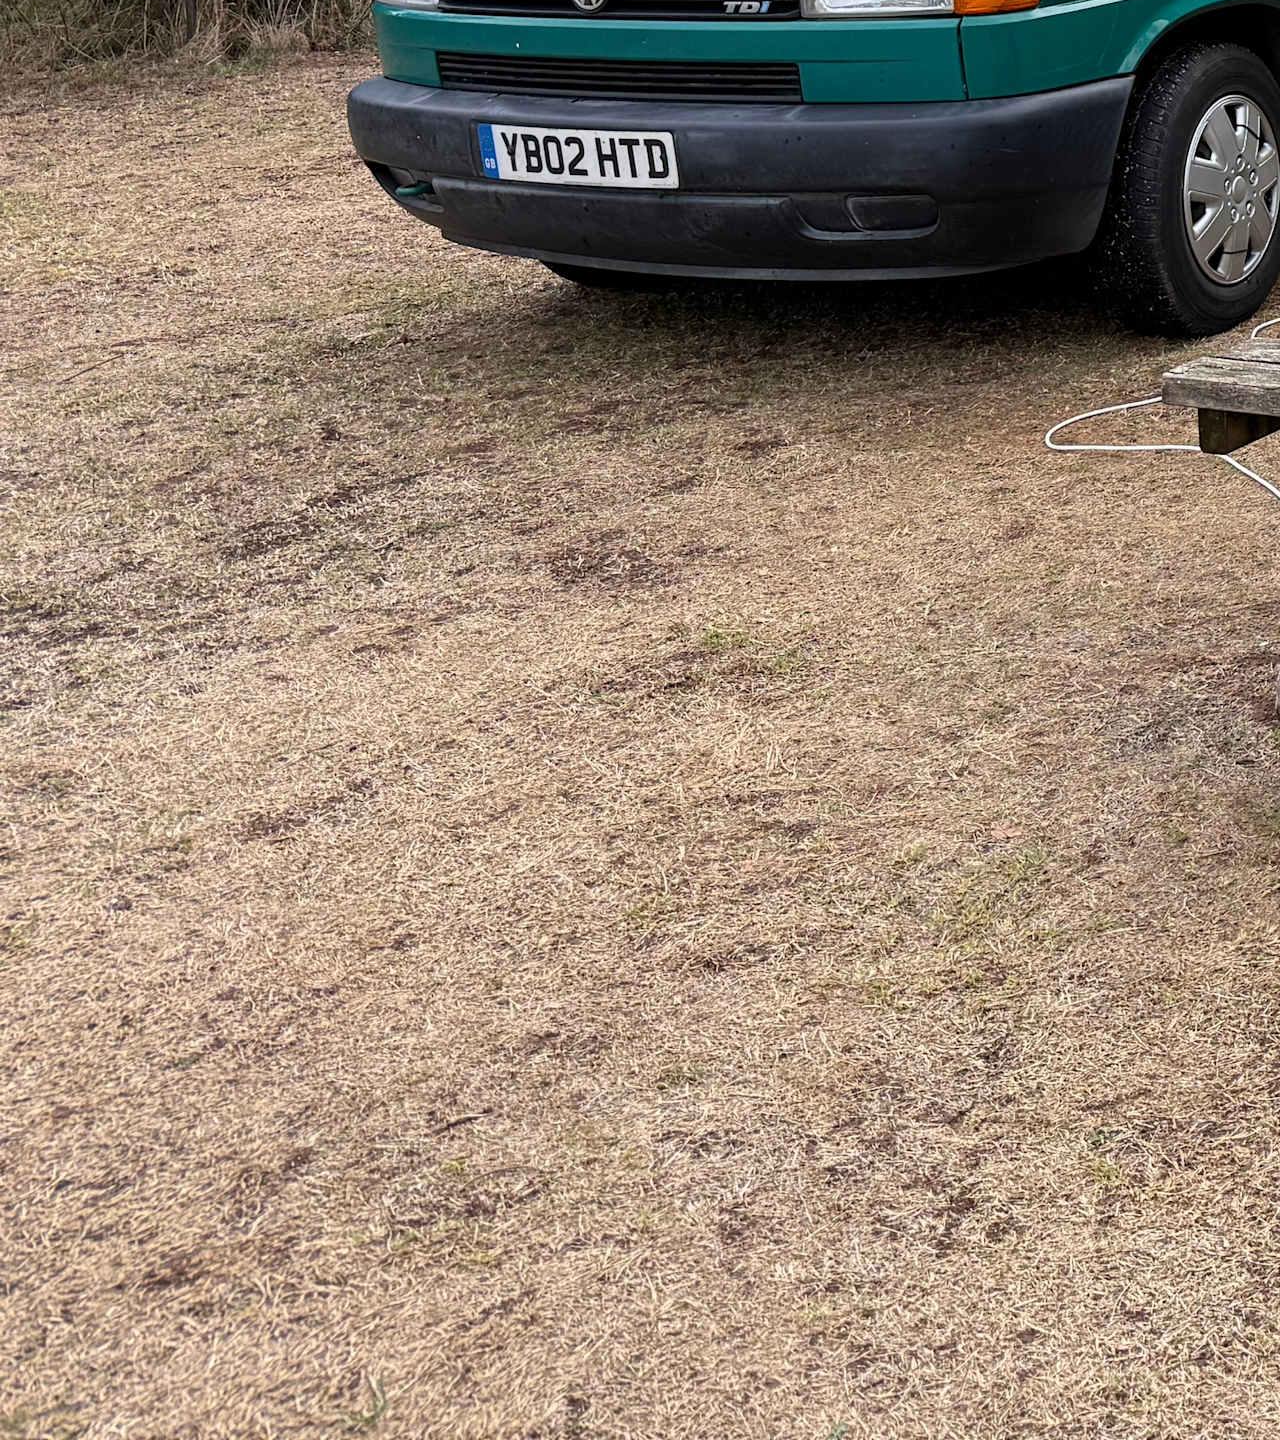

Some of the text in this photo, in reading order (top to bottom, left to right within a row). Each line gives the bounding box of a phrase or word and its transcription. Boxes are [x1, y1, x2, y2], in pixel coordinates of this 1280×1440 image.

[485, 158, 497, 169] GB
[501, 132, 669, 179] YB02 HTD
